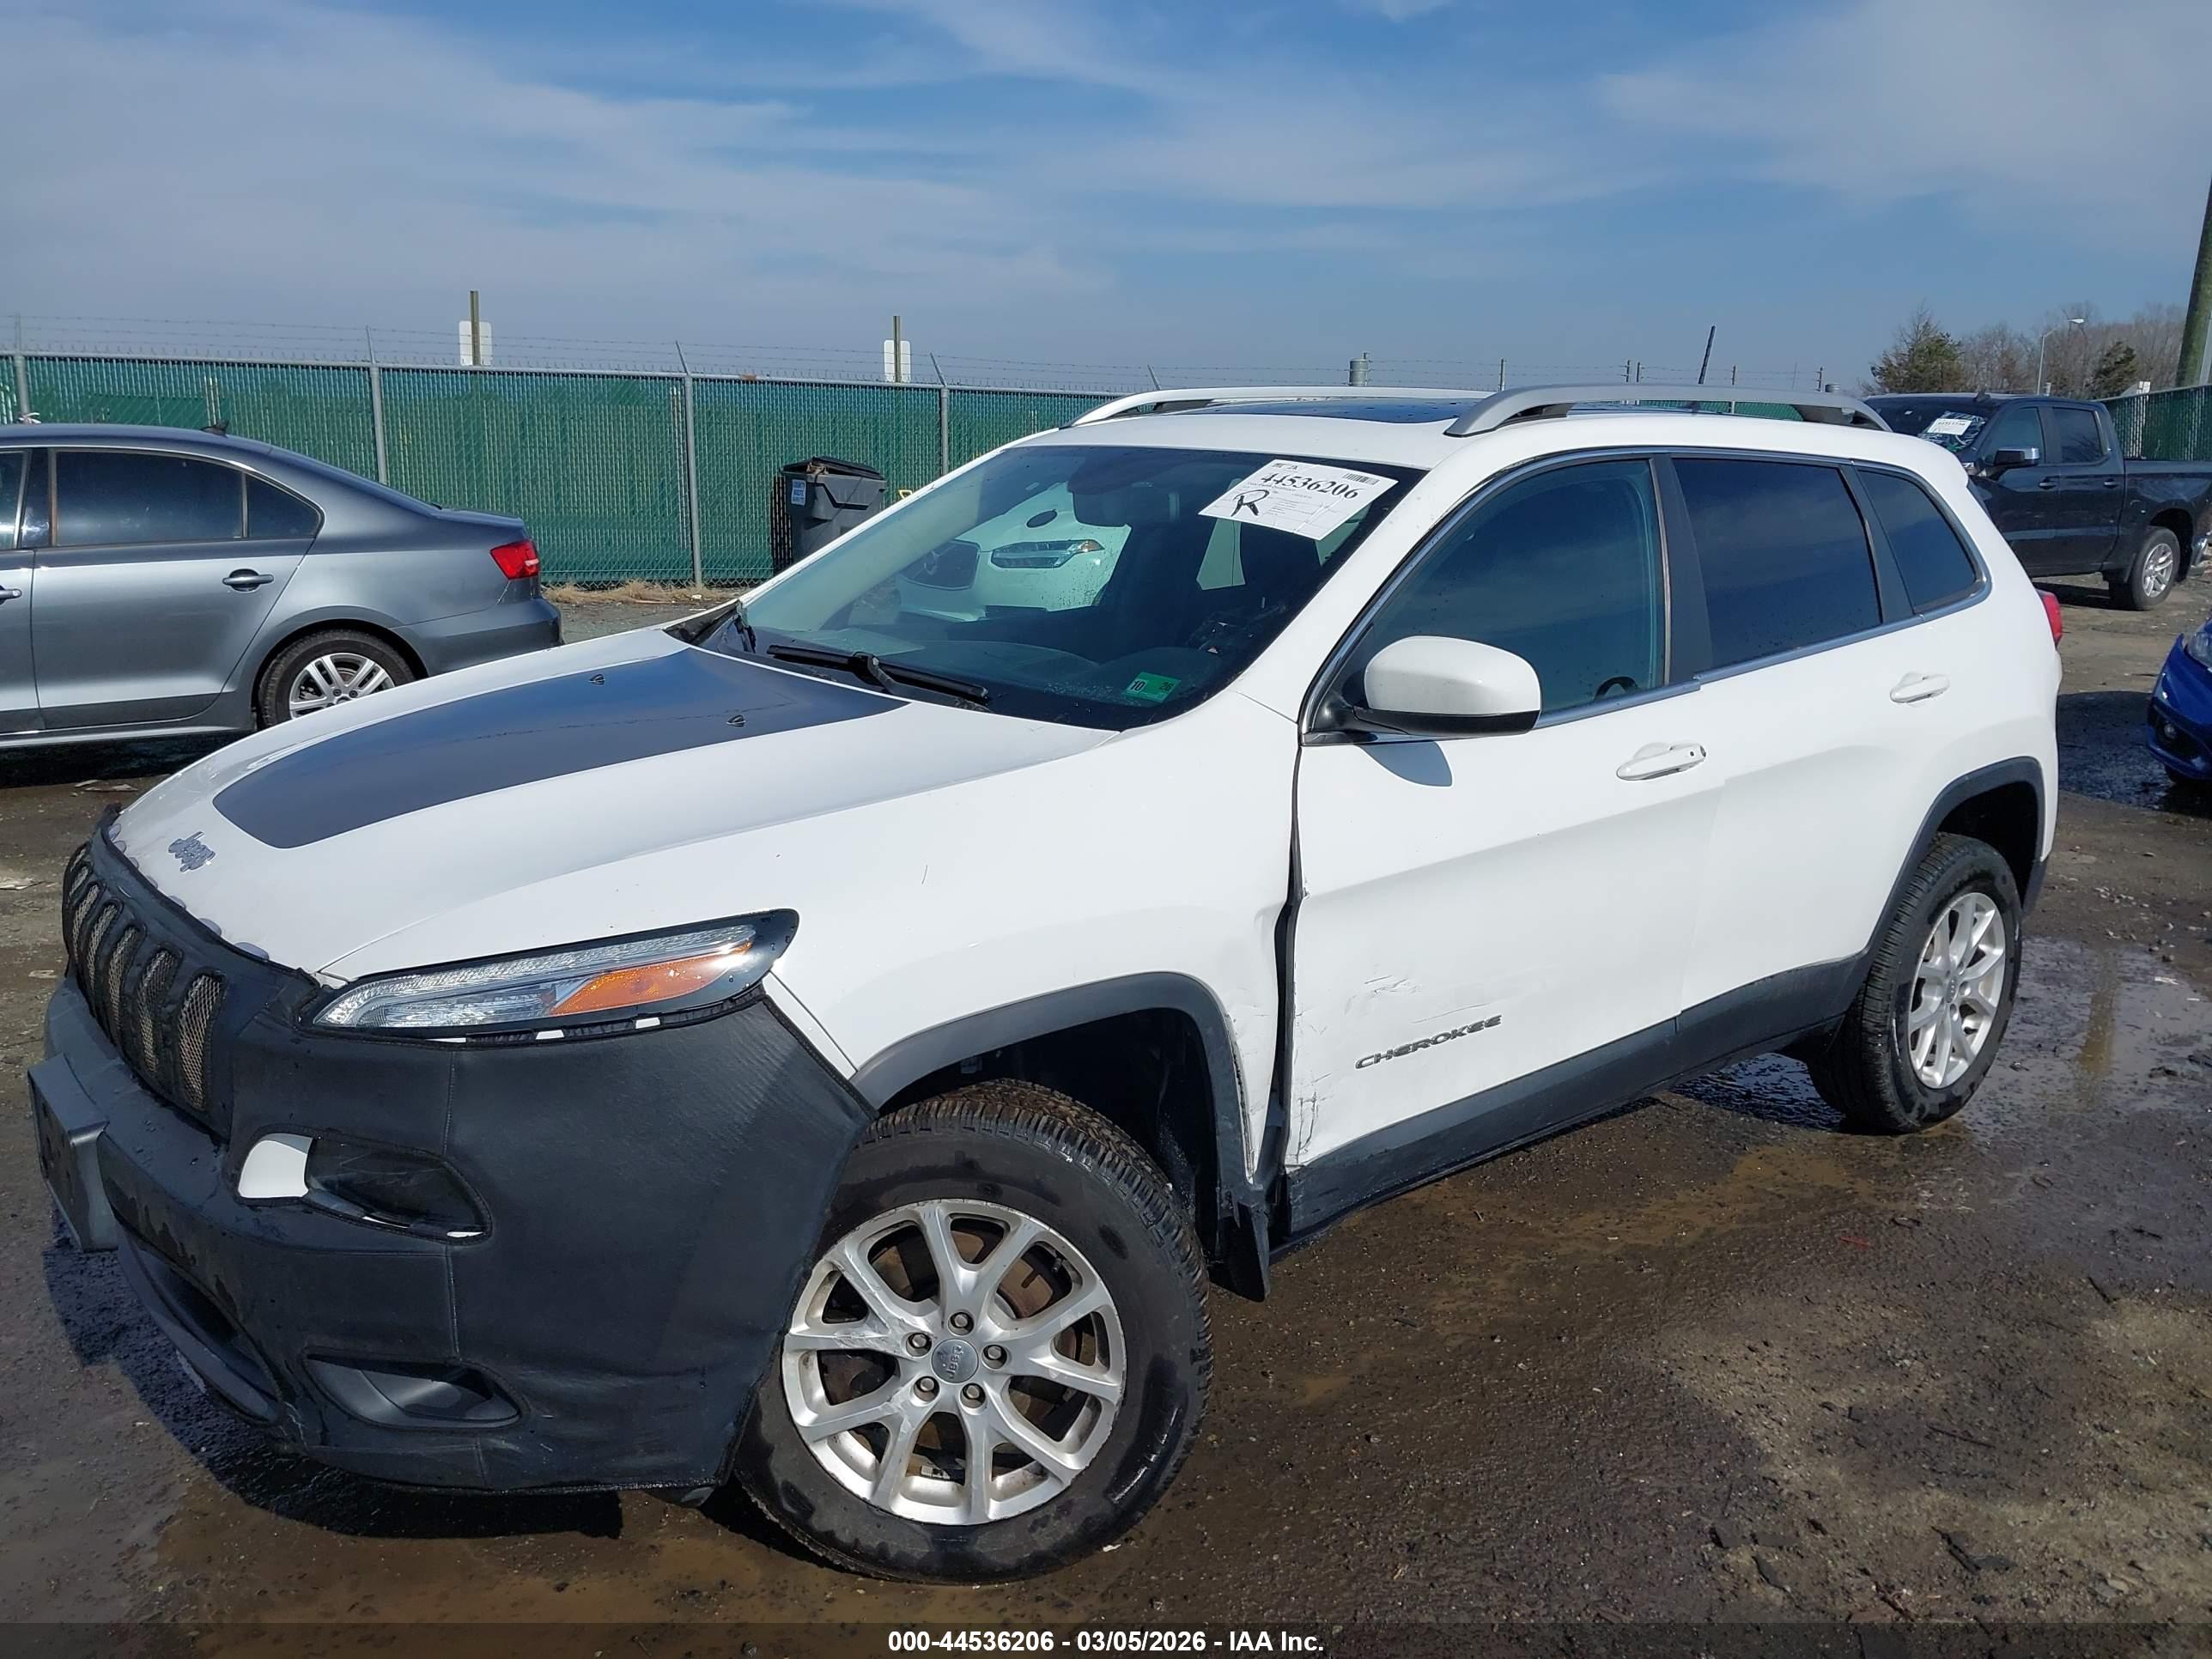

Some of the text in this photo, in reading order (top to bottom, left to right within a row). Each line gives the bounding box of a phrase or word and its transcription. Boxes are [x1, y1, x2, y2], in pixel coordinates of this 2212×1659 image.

[1261, 472, 1365, 500] 44536206
[1231, 489, 1270, 517] R
[1131, 680, 1146, 691] 10
[1355, 1015, 1502, 1069] CHEROKEE
